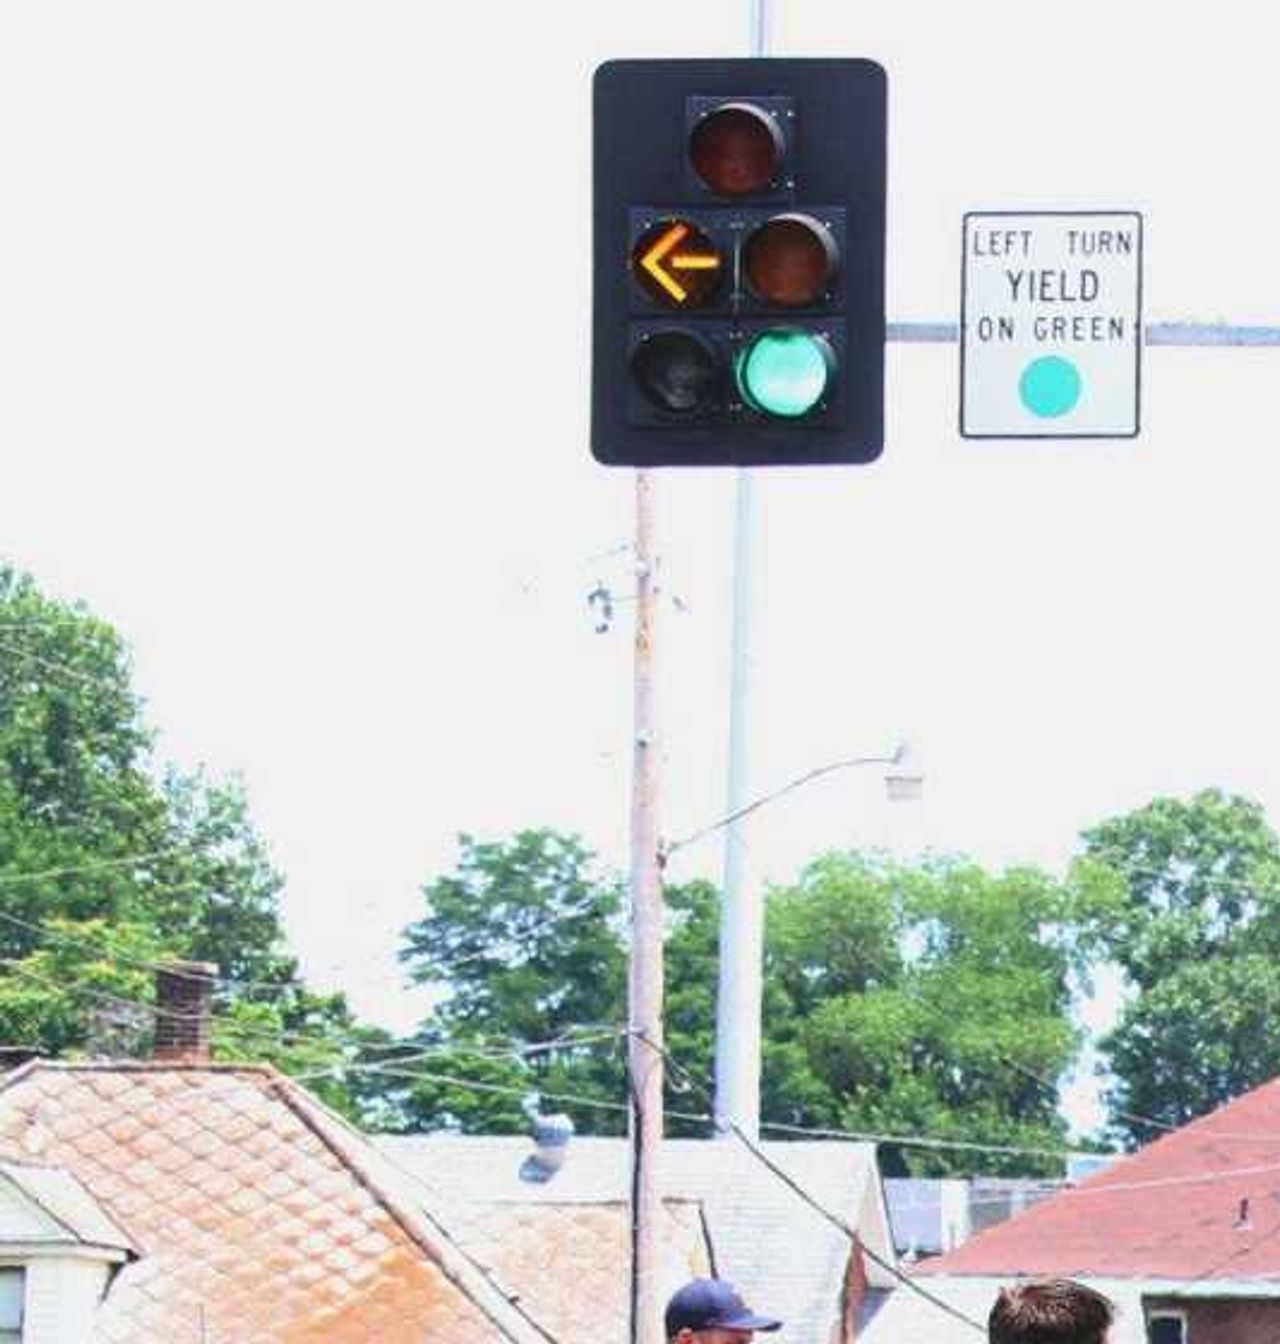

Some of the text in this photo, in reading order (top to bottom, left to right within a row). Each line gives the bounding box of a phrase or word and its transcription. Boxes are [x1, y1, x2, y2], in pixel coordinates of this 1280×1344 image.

[973, 230, 1133, 257] LEFT TURN
[1006, 269, 1100, 302] YIELD
[978, 317, 1124, 342] ON GREEN
